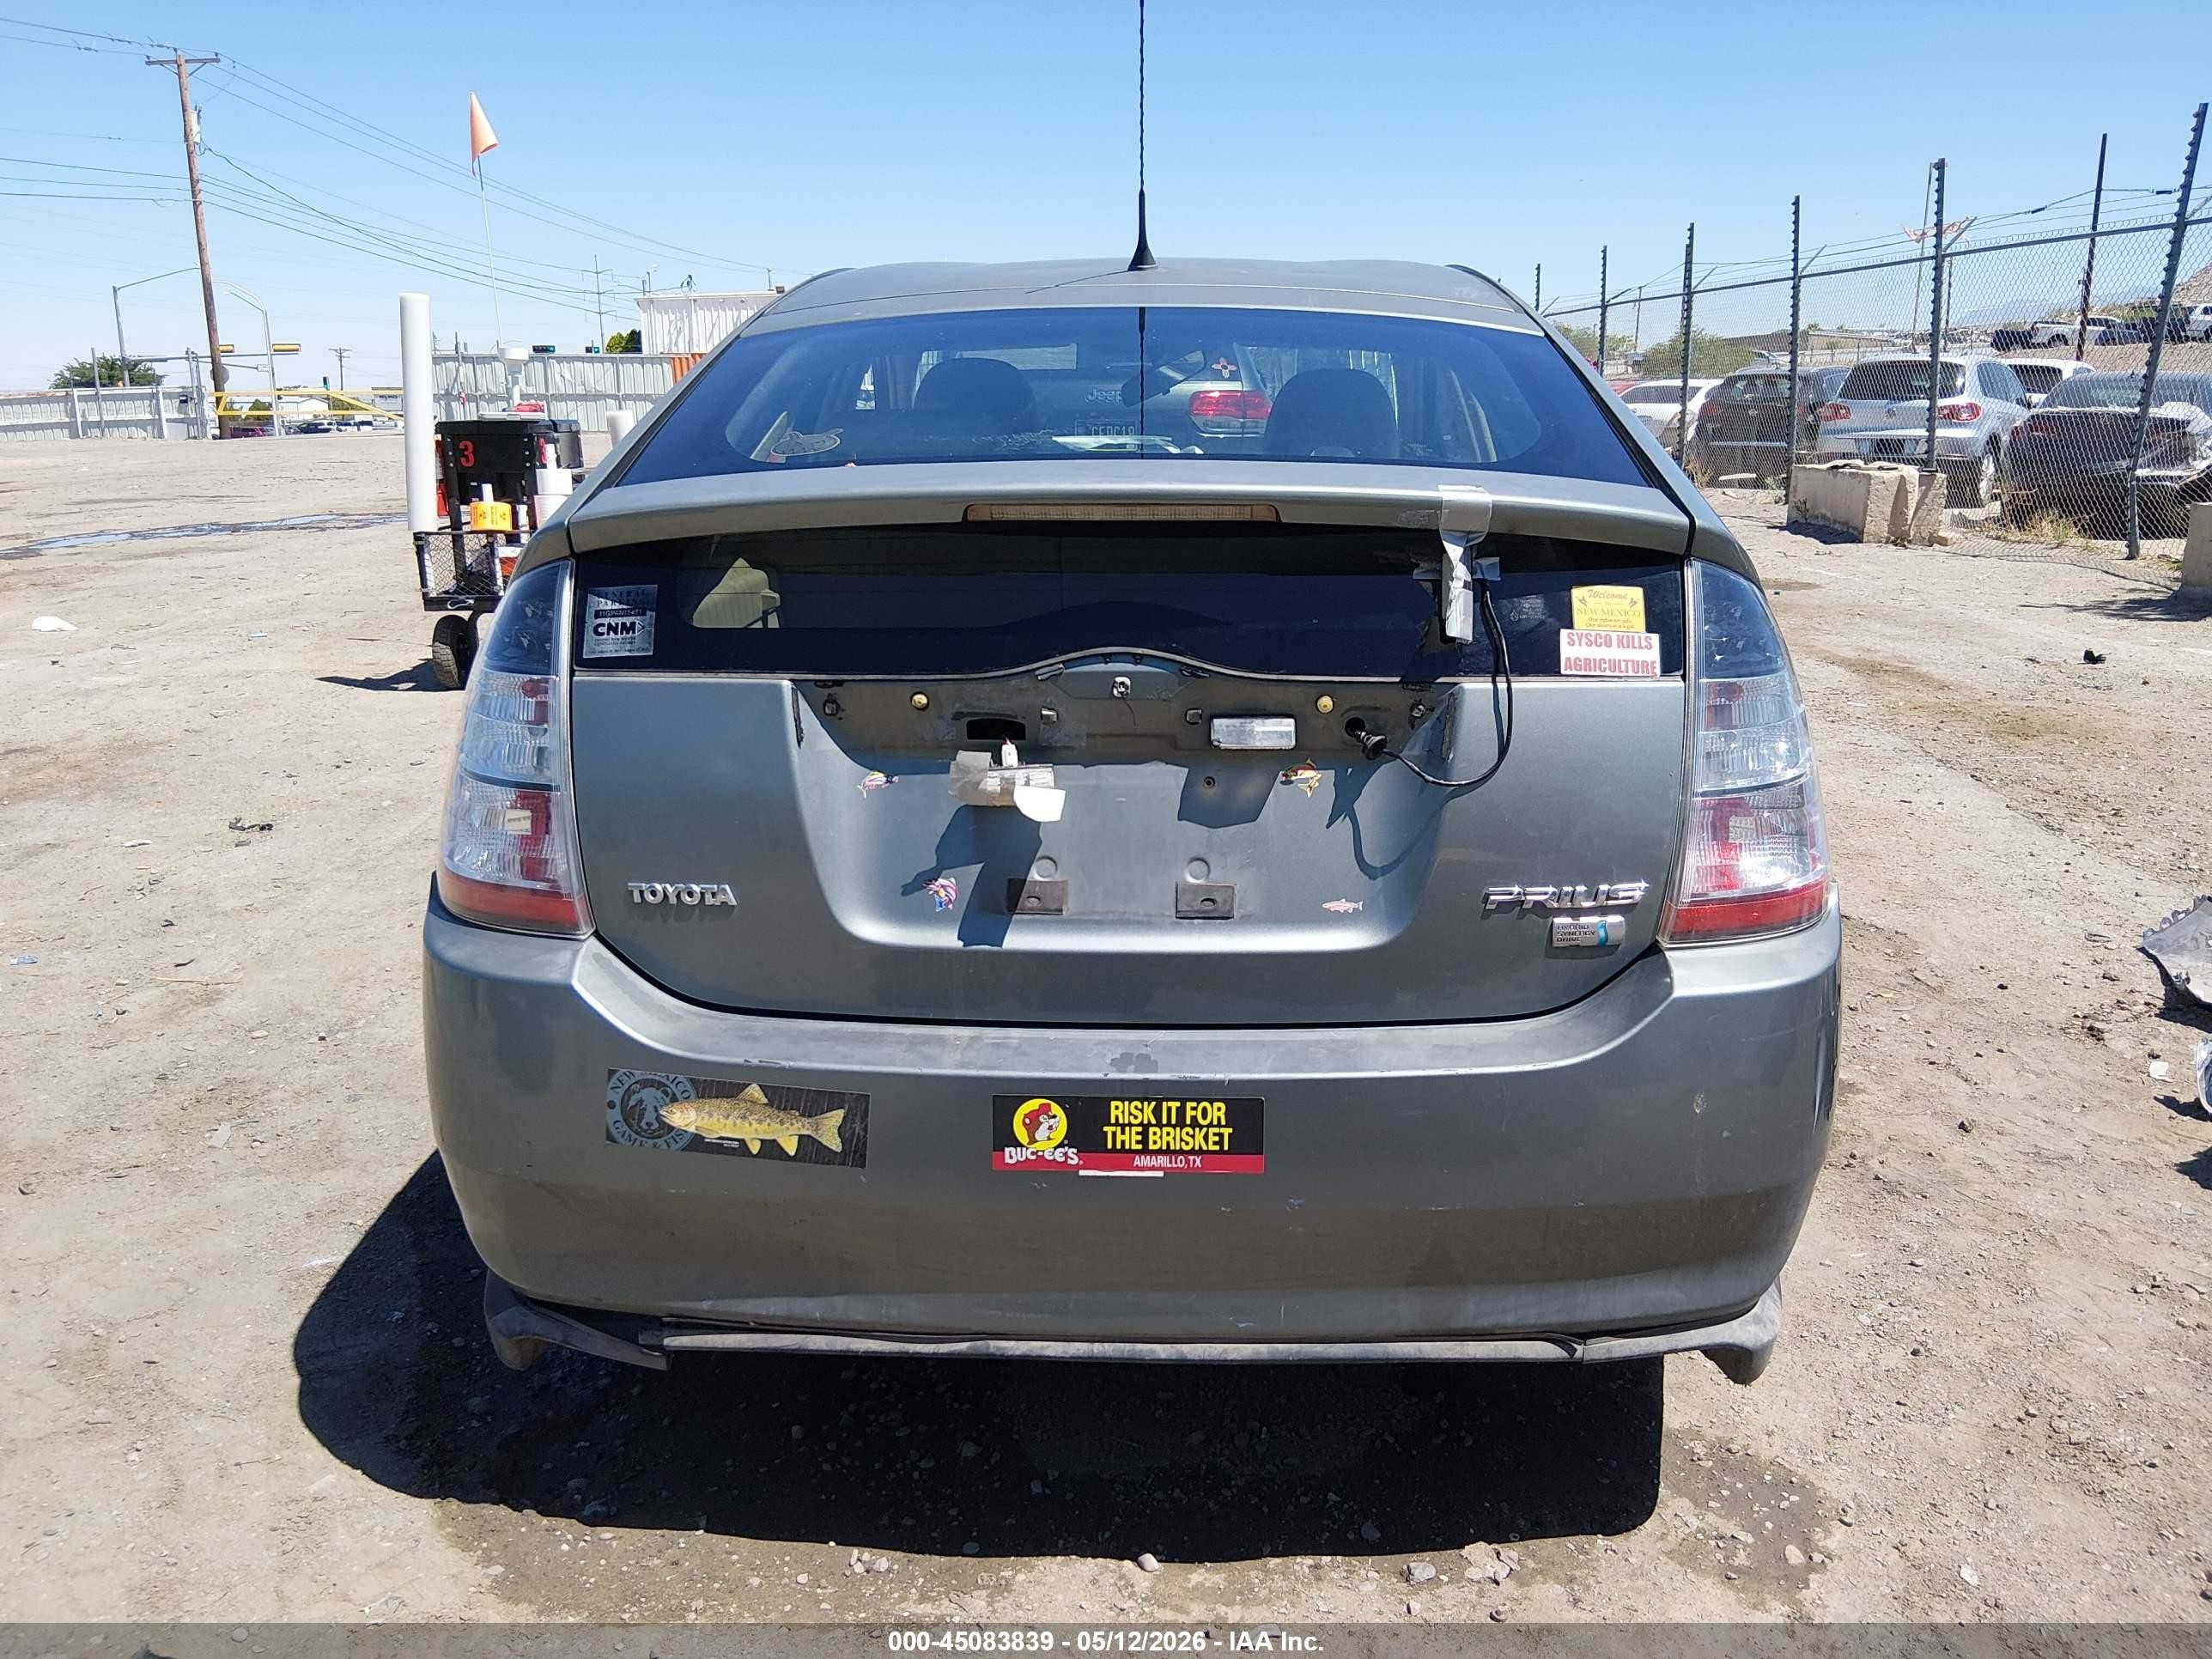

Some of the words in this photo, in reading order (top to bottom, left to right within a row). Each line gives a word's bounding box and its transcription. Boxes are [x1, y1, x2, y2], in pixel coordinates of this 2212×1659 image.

[1085, 388, 1121, 404] Jeep
[459, 441, 475, 466] 3
[1587, 589, 1628, 599] Welcome
[1601, 609, 1641, 617] MEXICO
[592, 622, 636, 636] CNM
[1567, 632, 1612, 648] SYSCO
[1616, 635, 1652, 650] KILLS
[1564, 657, 1657, 676] AGRICULTURE
[627, 883, 738, 905] TOYOTA
[1484, 878, 1650, 909] PRIUS
[611, 1070, 635, 1094] NEW
[1110, 1100, 1156, 1125] RISK
[1161, 1101, 1182, 1125] IT
[1186, 1101, 1226, 1126] FOR
[665, 1131, 684, 1149] FIS
[1103, 1127, 1142, 1150] THE
[1148, 1127, 1233, 1151] BRISKET
